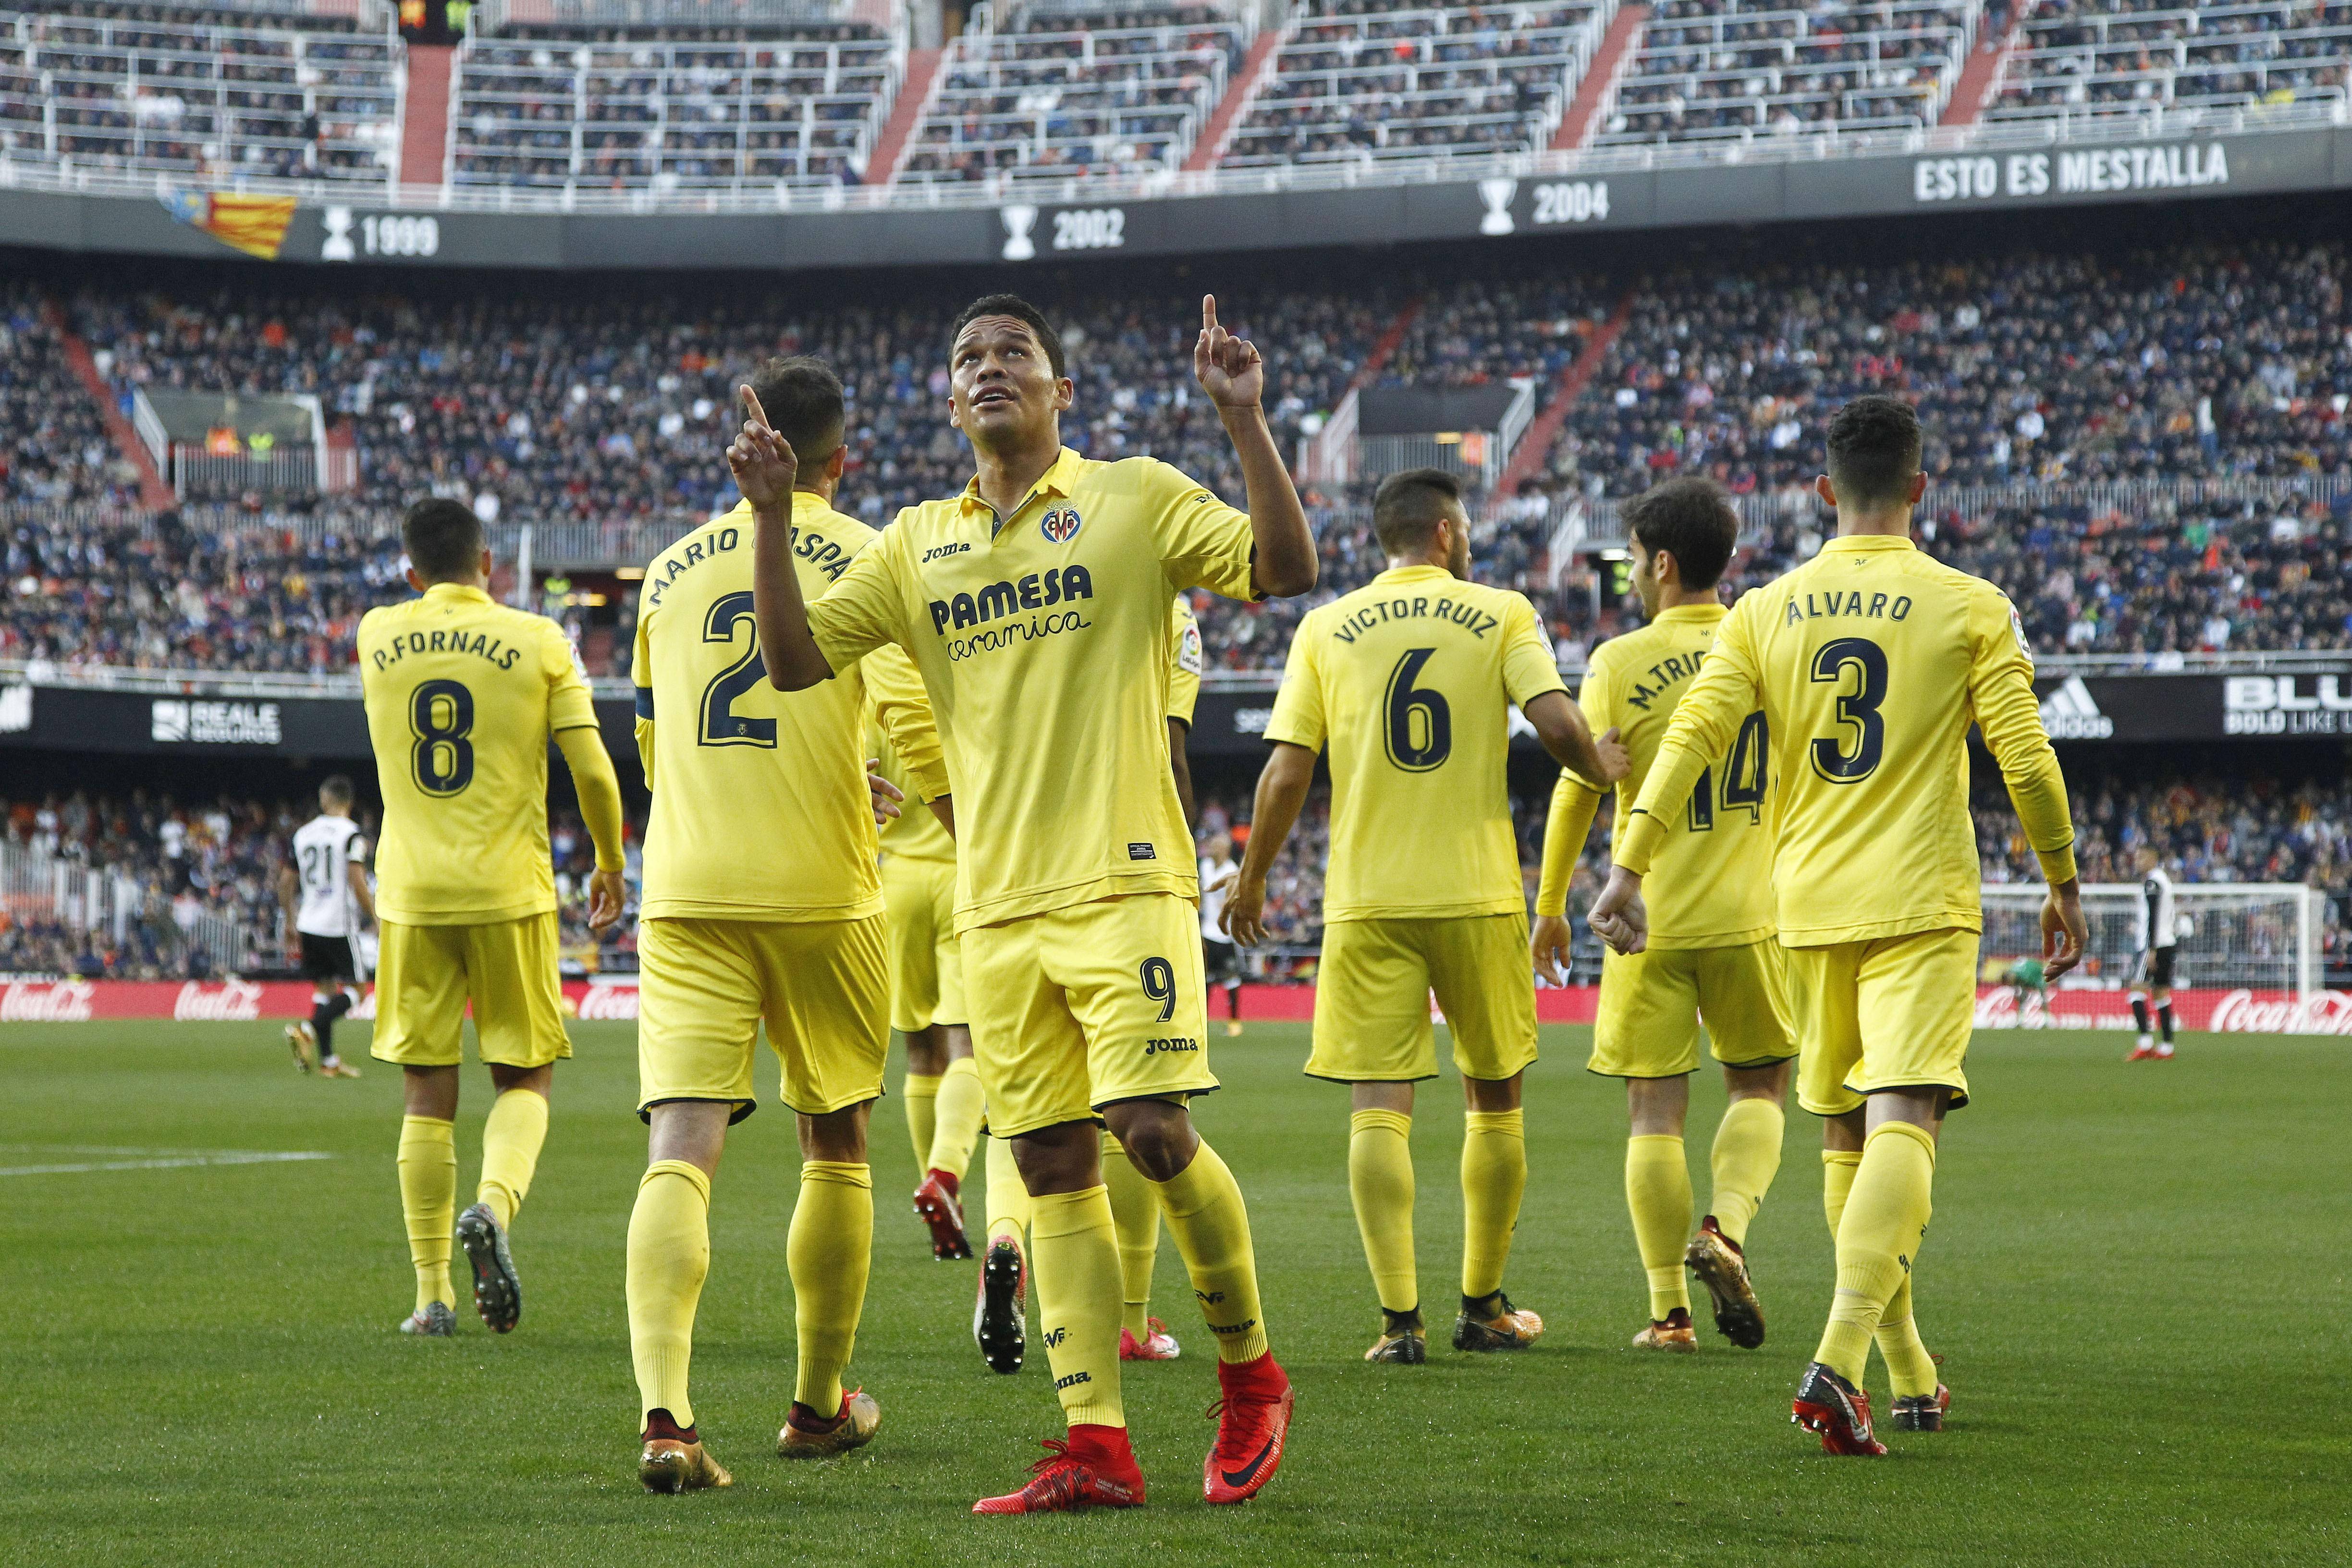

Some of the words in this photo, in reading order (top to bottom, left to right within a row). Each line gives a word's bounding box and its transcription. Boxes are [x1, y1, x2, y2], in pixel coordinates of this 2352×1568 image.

[1915, 156, 1997, 201] ESTO
[2007, 149, 2050, 196] ES
[2058, 143, 2229, 193] MESTALLA
[1532, 182, 1610, 224] 2004
[1053, 208, 1126, 250] 2002
[649, 528, 739, 607] MARIO
[929, 565, 1093, 636] PAMESA
[1333, 597, 1427, 645] VÍCTOR
[1433, 598, 1498, 640] RUIZ
[1787, 591, 1913, 628] ÁLVARO
[372, 630, 520, 672] P.FORNALS
[947, 611, 1091, 662] ceramica
[697, 591, 777, 749] 2
[191, 701, 281, 724] REALE
[1383, 647, 1452, 773] 6
[1810, 637, 1889, 784] 3
[2042, 714, 2113, 739] didas
[2225, 712, 2287, 734] BOLD
[2288, 712, 2338, 733] LIKE
[408, 679, 474, 798] 8
[1688, 710, 1770, 832] 14
[303, 844, 332, 884] 21
[1139, 956, 1176, 1023] 9
[1207, 1319, 1256, 1333] oma
